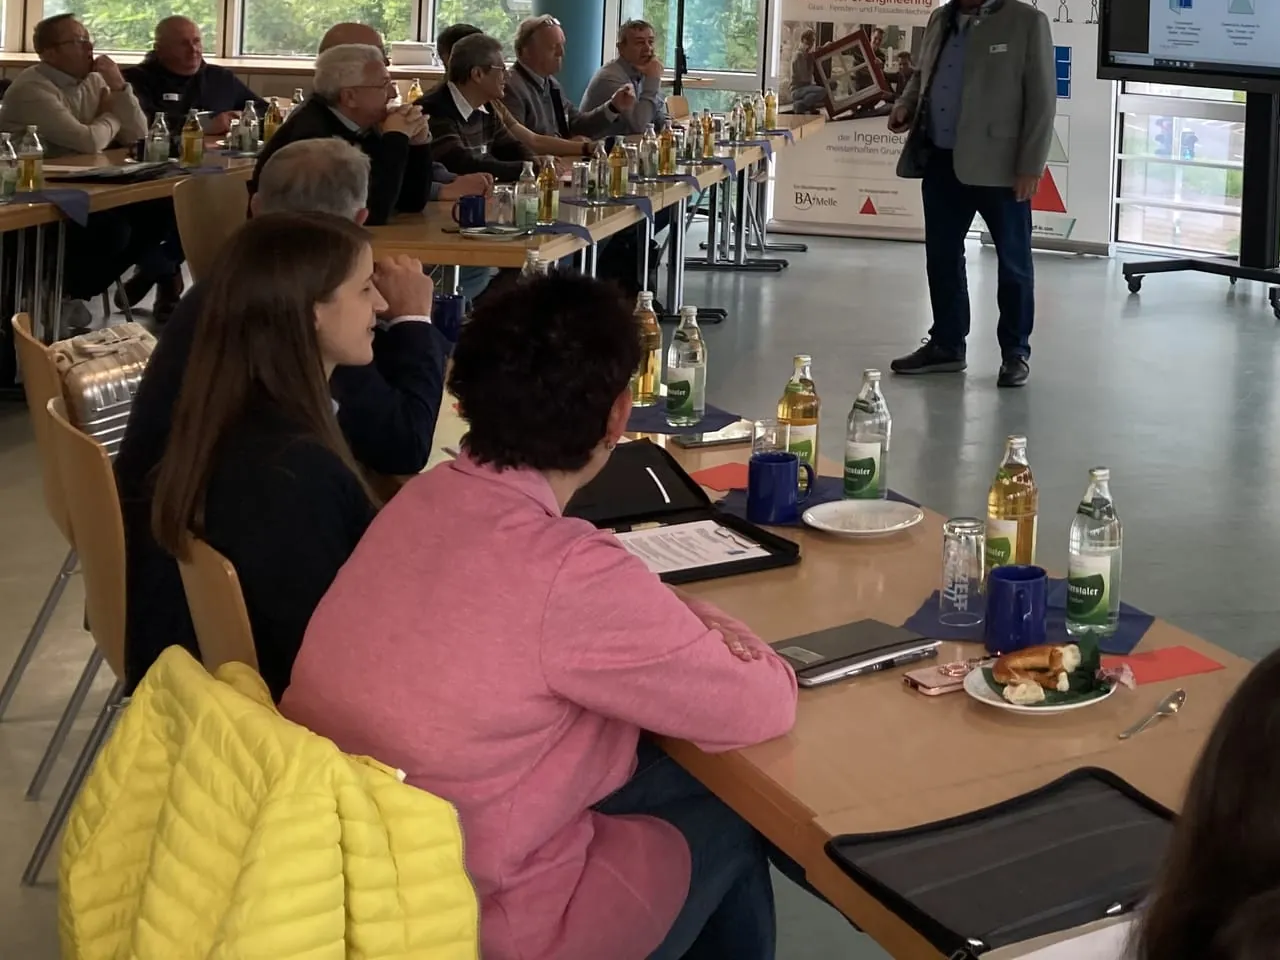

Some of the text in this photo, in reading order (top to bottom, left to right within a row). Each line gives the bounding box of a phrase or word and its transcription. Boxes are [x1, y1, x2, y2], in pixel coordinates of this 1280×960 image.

[854, 131, 906, 146] Ingenieu
[795, 192, 838, 207] BA Melle
